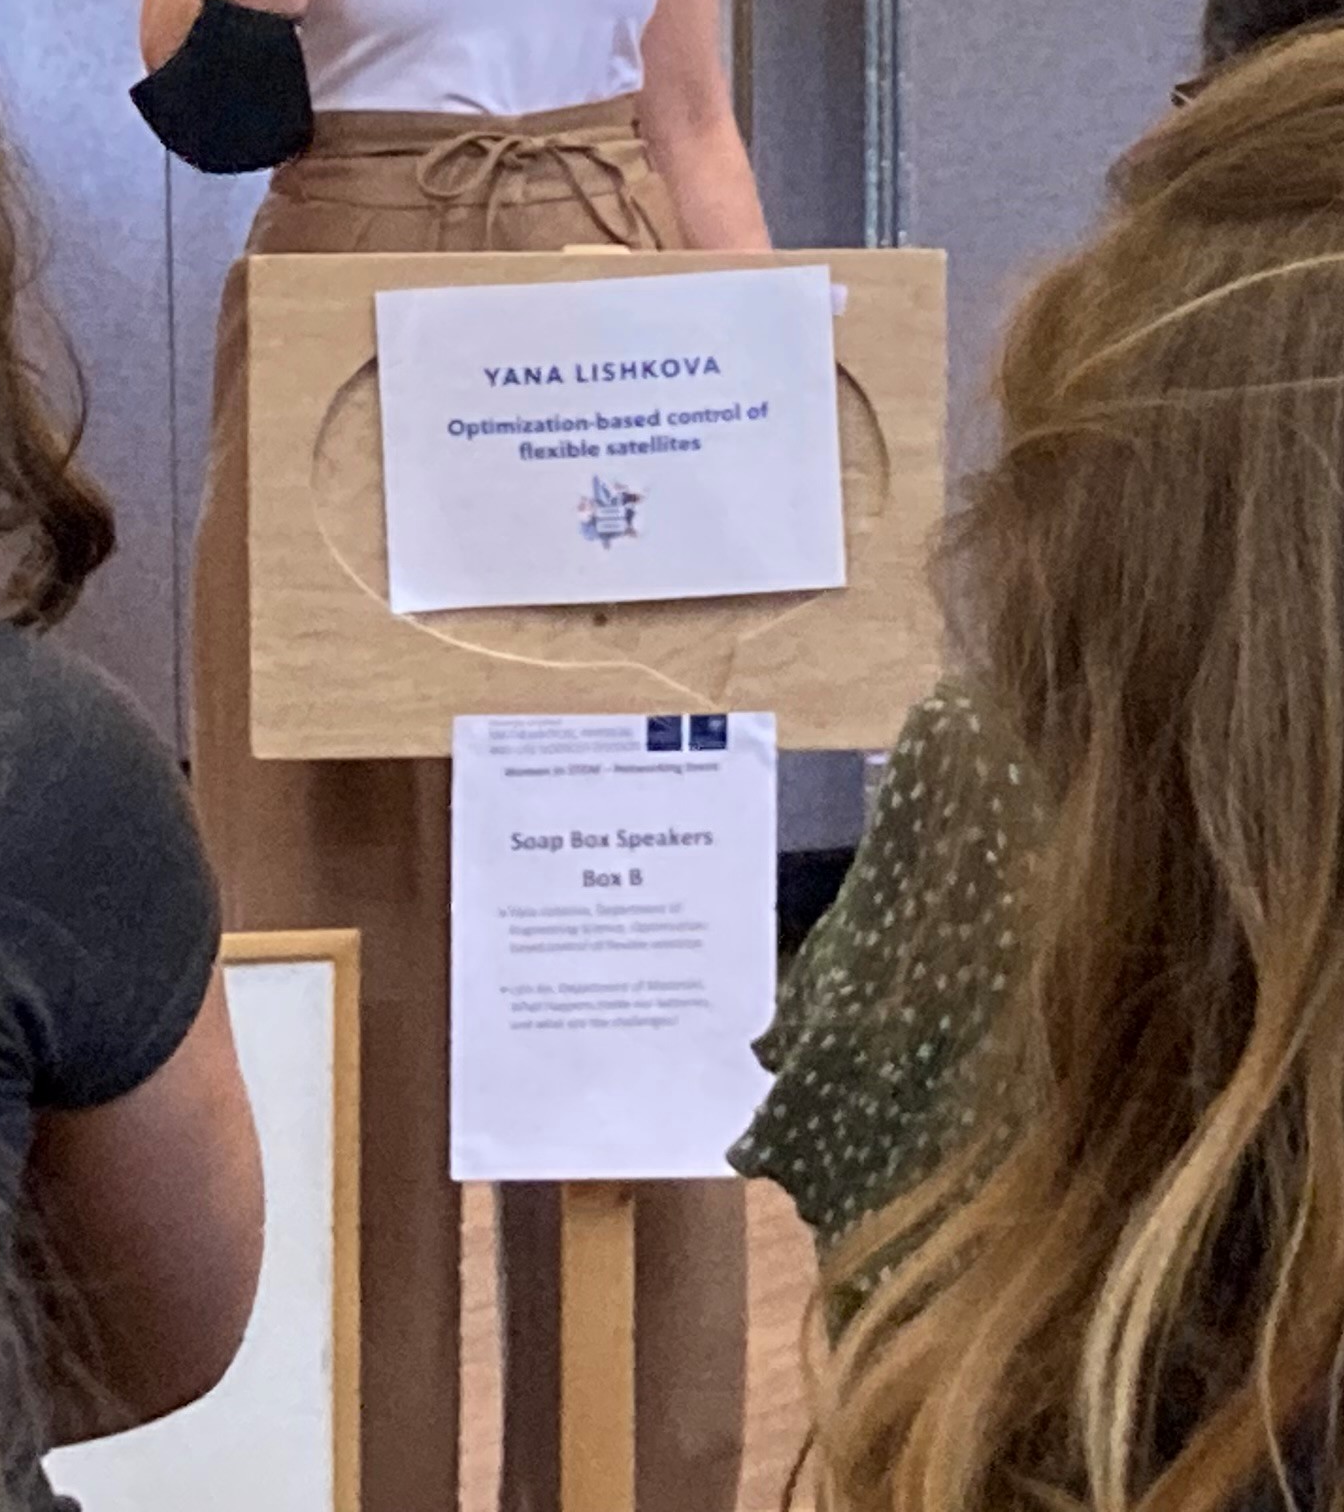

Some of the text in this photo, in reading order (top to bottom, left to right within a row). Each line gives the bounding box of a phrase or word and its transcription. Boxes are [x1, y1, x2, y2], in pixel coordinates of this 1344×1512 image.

[484, 356, 721, 387] YANA LISHKOVA
[447, 402, 769, 439] Optimization-based control of
[519, 436, 702, 461] flexible satellites
[511, 828, 713, 852] Soap Box Speakers
[582, 868, 643, 888] Box B
